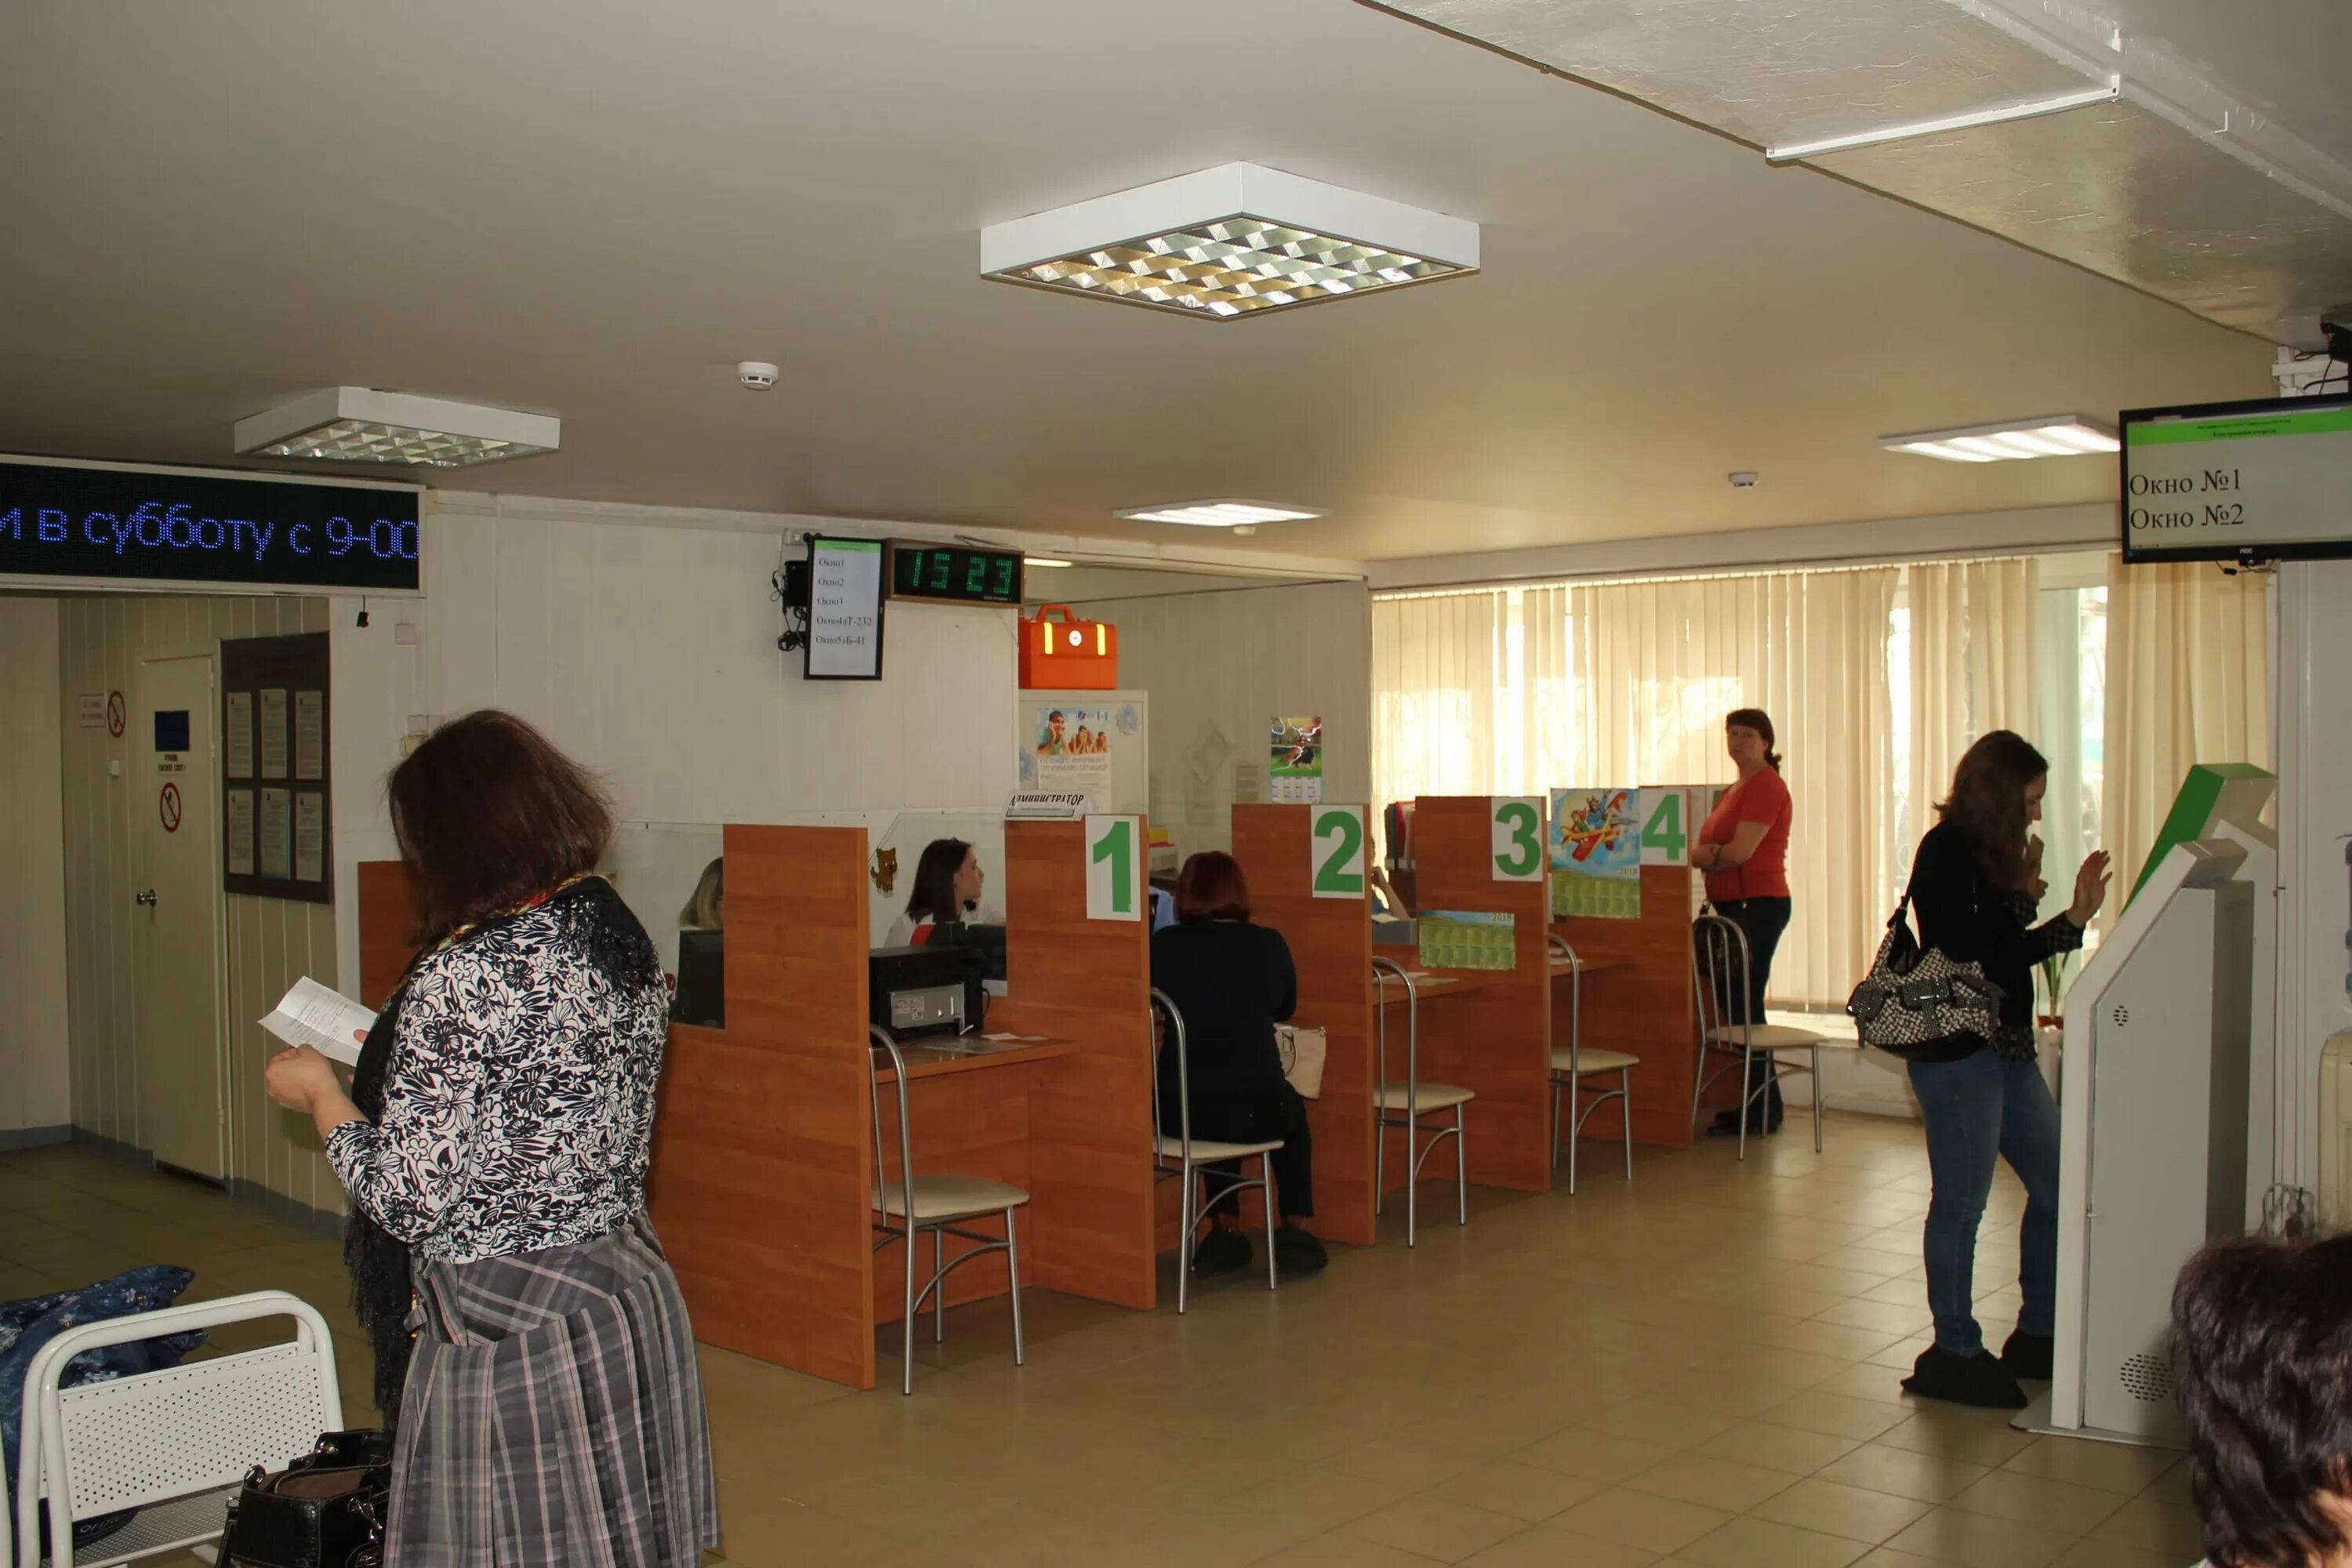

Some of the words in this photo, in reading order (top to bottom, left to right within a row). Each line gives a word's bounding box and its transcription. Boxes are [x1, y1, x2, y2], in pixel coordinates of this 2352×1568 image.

[2129, 474, 2194, 496] Окно
[2201, 469, 2240, 492] №1
[84, 502, 274, 561] субботу
[326, 516, 419, 559] 9-00
[2130, 508, 2194, 530] Окно
[2201, 503, 2244, 527] №2
[1314, 811, 1363, 893] 2
[1494, 802, 1541, 877] 3
[1642, 794, 1686, 861] 4
[1093, 821, 1131, 913] 1
